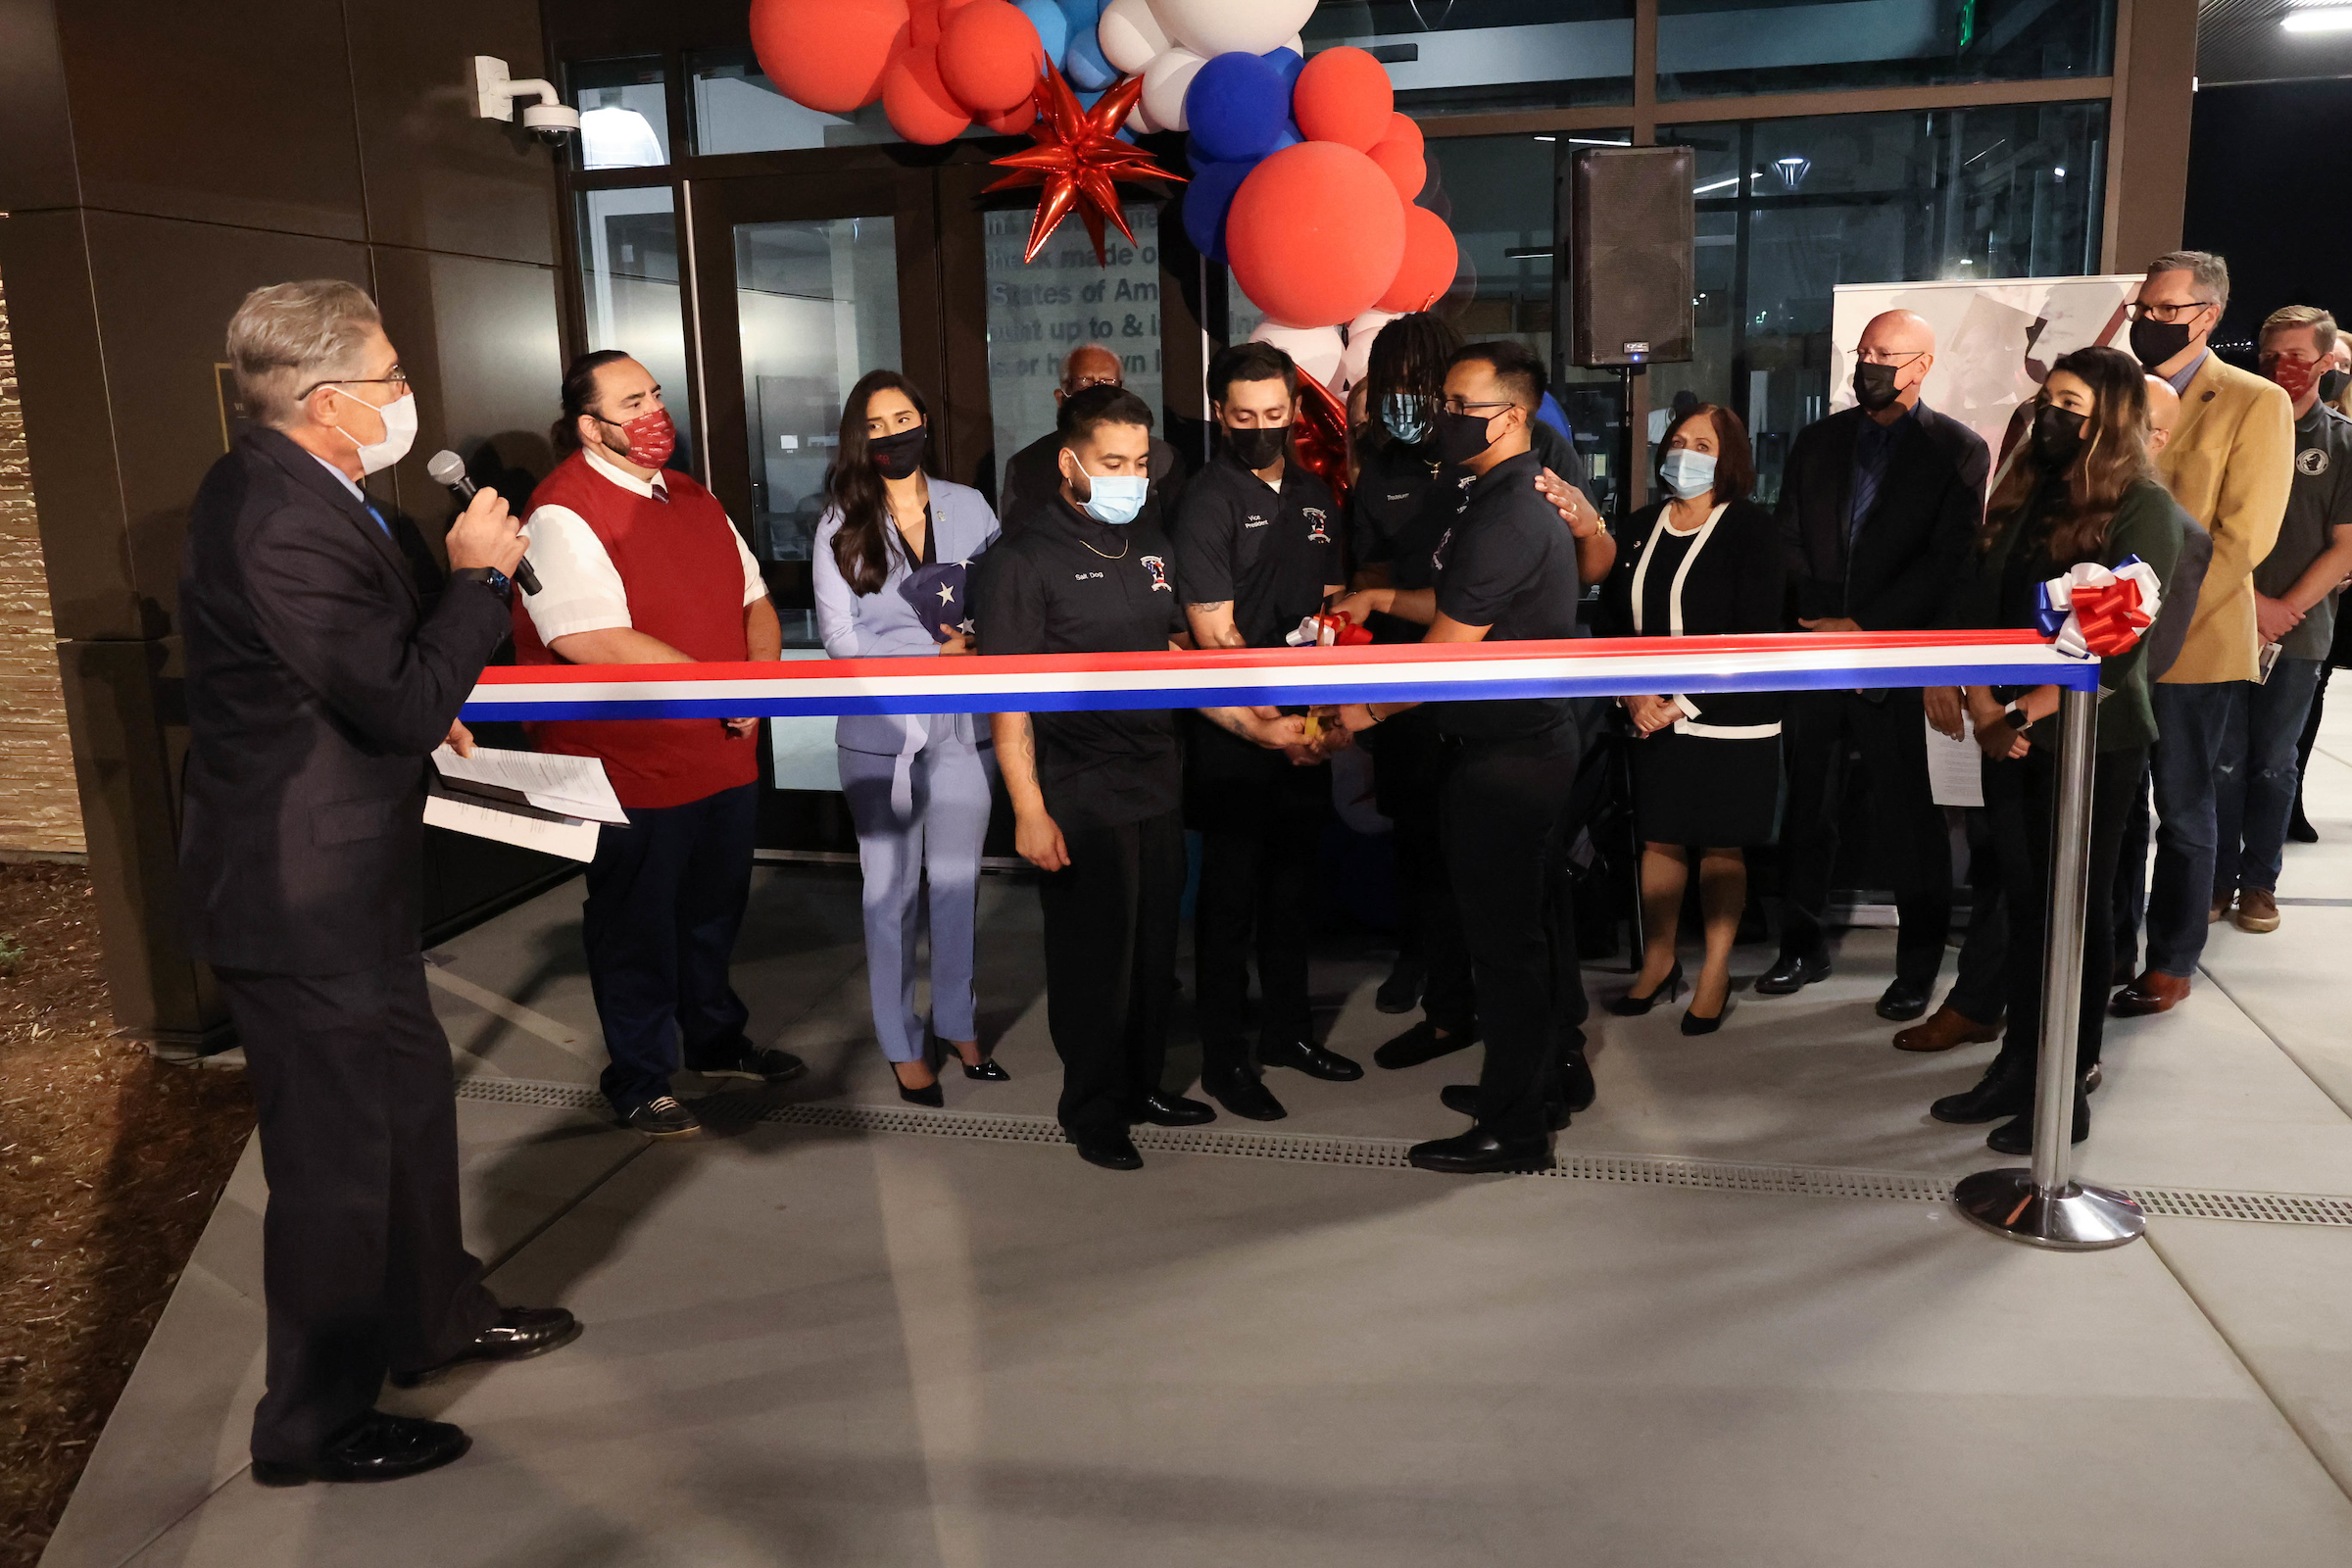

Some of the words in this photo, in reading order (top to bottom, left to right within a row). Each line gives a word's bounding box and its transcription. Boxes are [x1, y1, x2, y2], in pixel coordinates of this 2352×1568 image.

[1082, 278, 1106, 305] of
[1050, 320, 1081, 345] up
[1089, 317, 1114, 340] to
[1121, 313, 1144, 338] &
